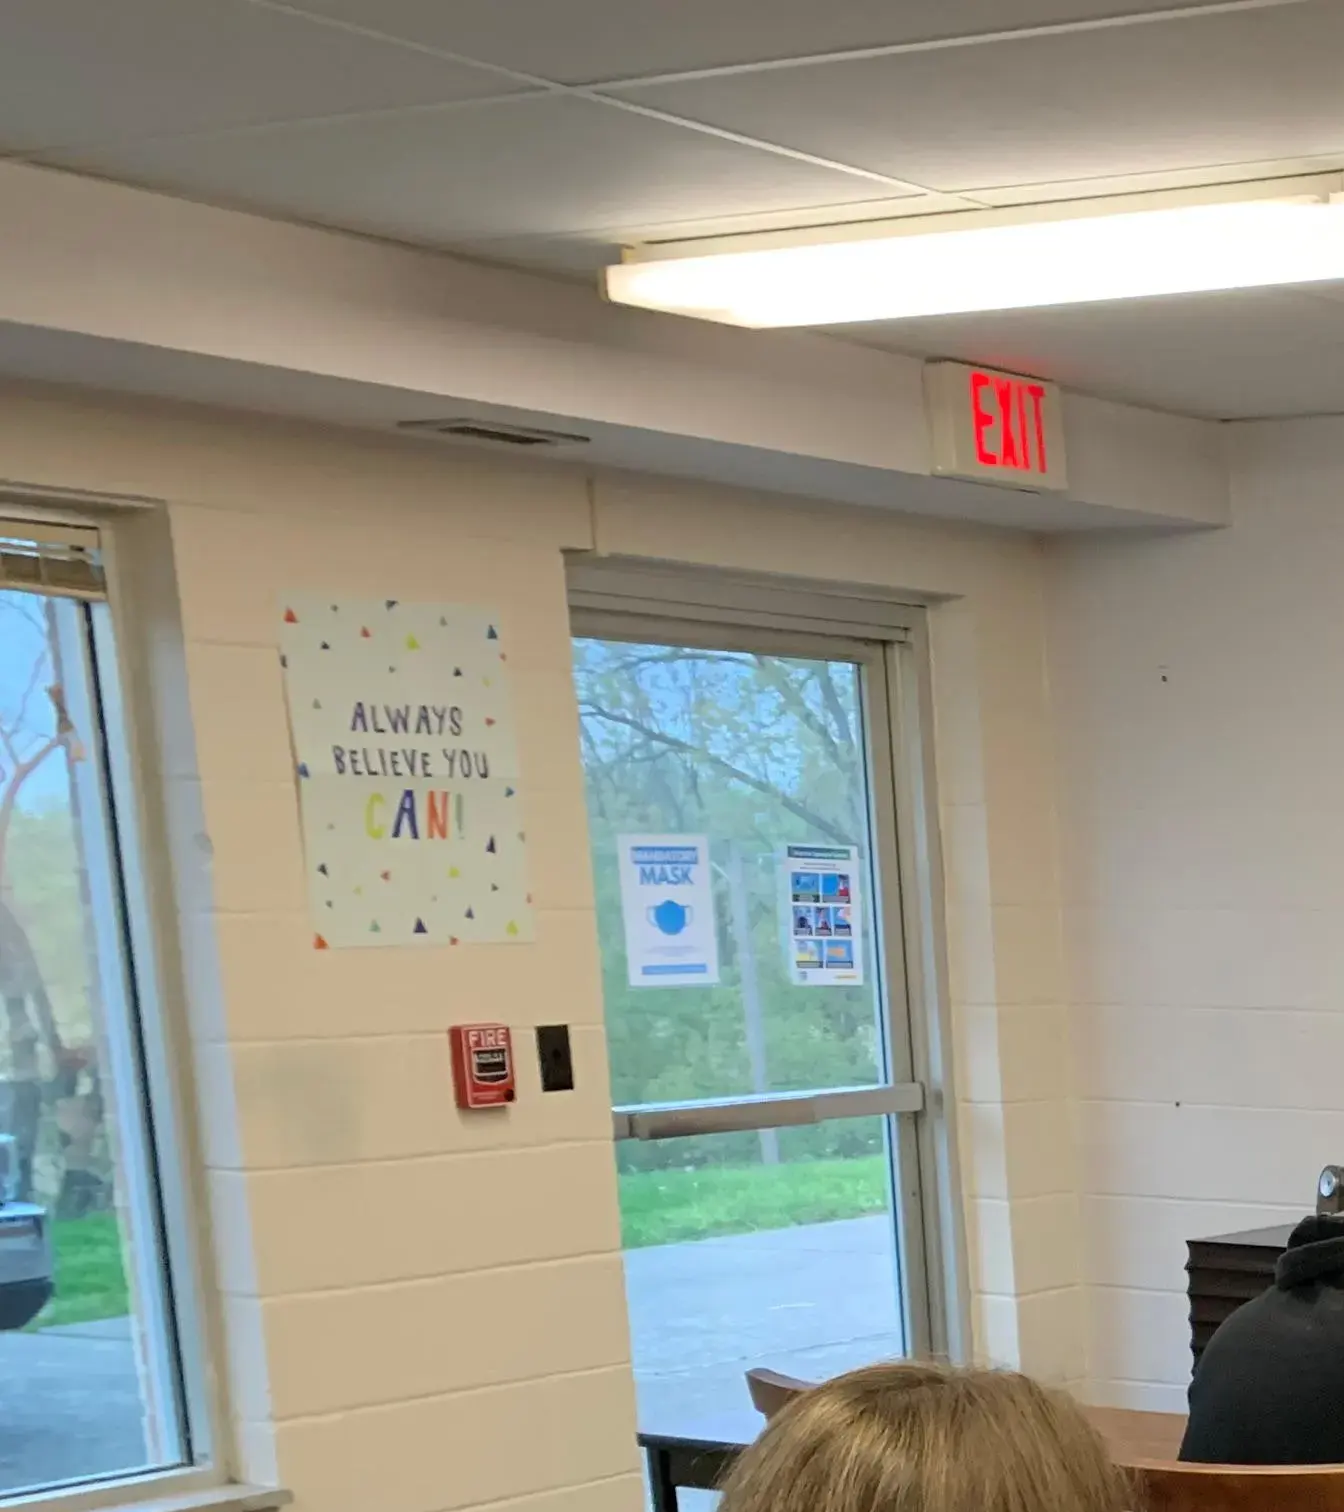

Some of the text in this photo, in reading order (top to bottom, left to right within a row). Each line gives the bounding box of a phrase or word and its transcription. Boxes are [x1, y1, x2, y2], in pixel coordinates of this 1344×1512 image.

[970, 371, 1048, 475] EXIT
[350, 702, 463, 736] ALWAYS
[332, 745, 490, 779] BELIEVE YOU
[364, 789, 465, 840] CAN!
[638, 866, 695, 886] MASK
[468, 1029, 508, 1048] FIRE
